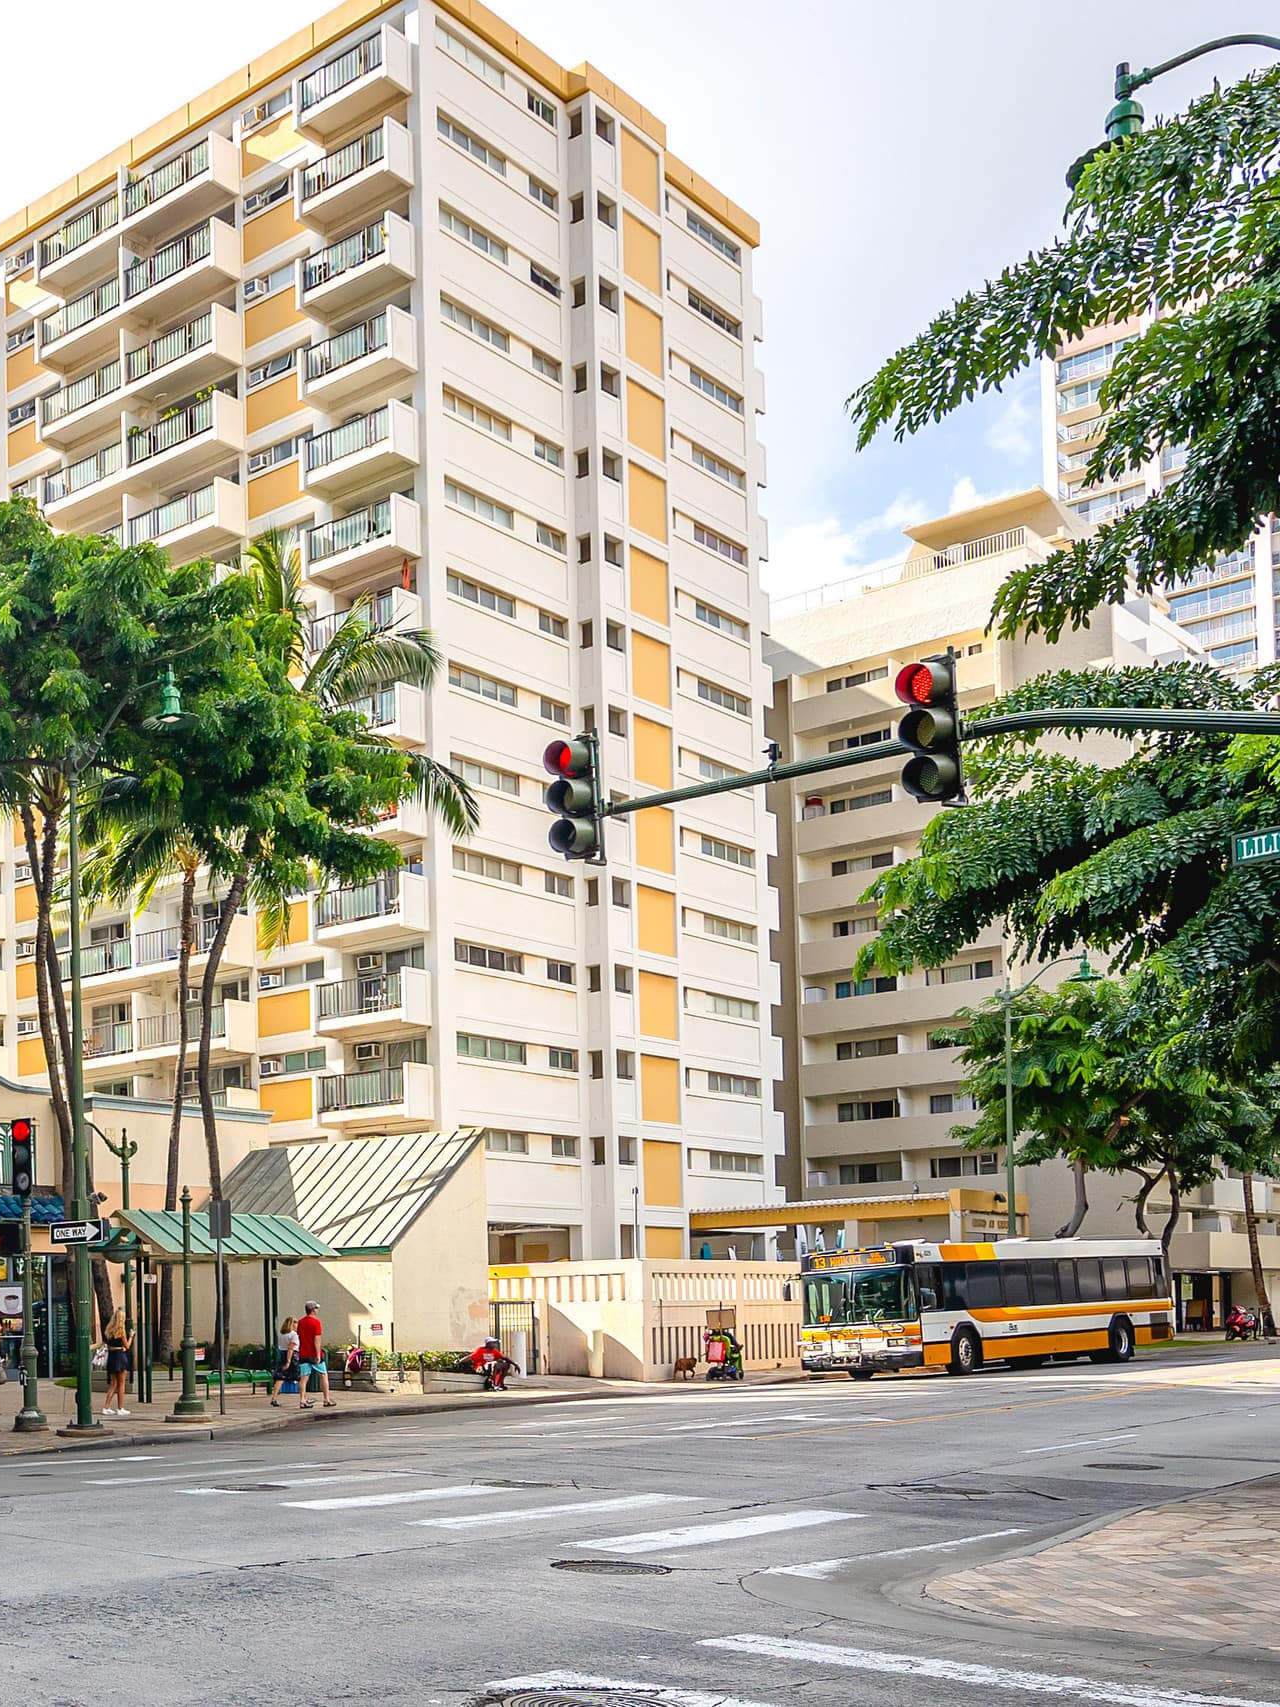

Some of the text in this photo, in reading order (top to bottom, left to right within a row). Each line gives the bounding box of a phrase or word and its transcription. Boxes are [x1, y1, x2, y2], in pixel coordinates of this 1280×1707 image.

[1240, 833, 1280, 859] LILI
[55, 1227, 86, 1238] ONE WAY
[814, 1257, 826, 1269] 13
